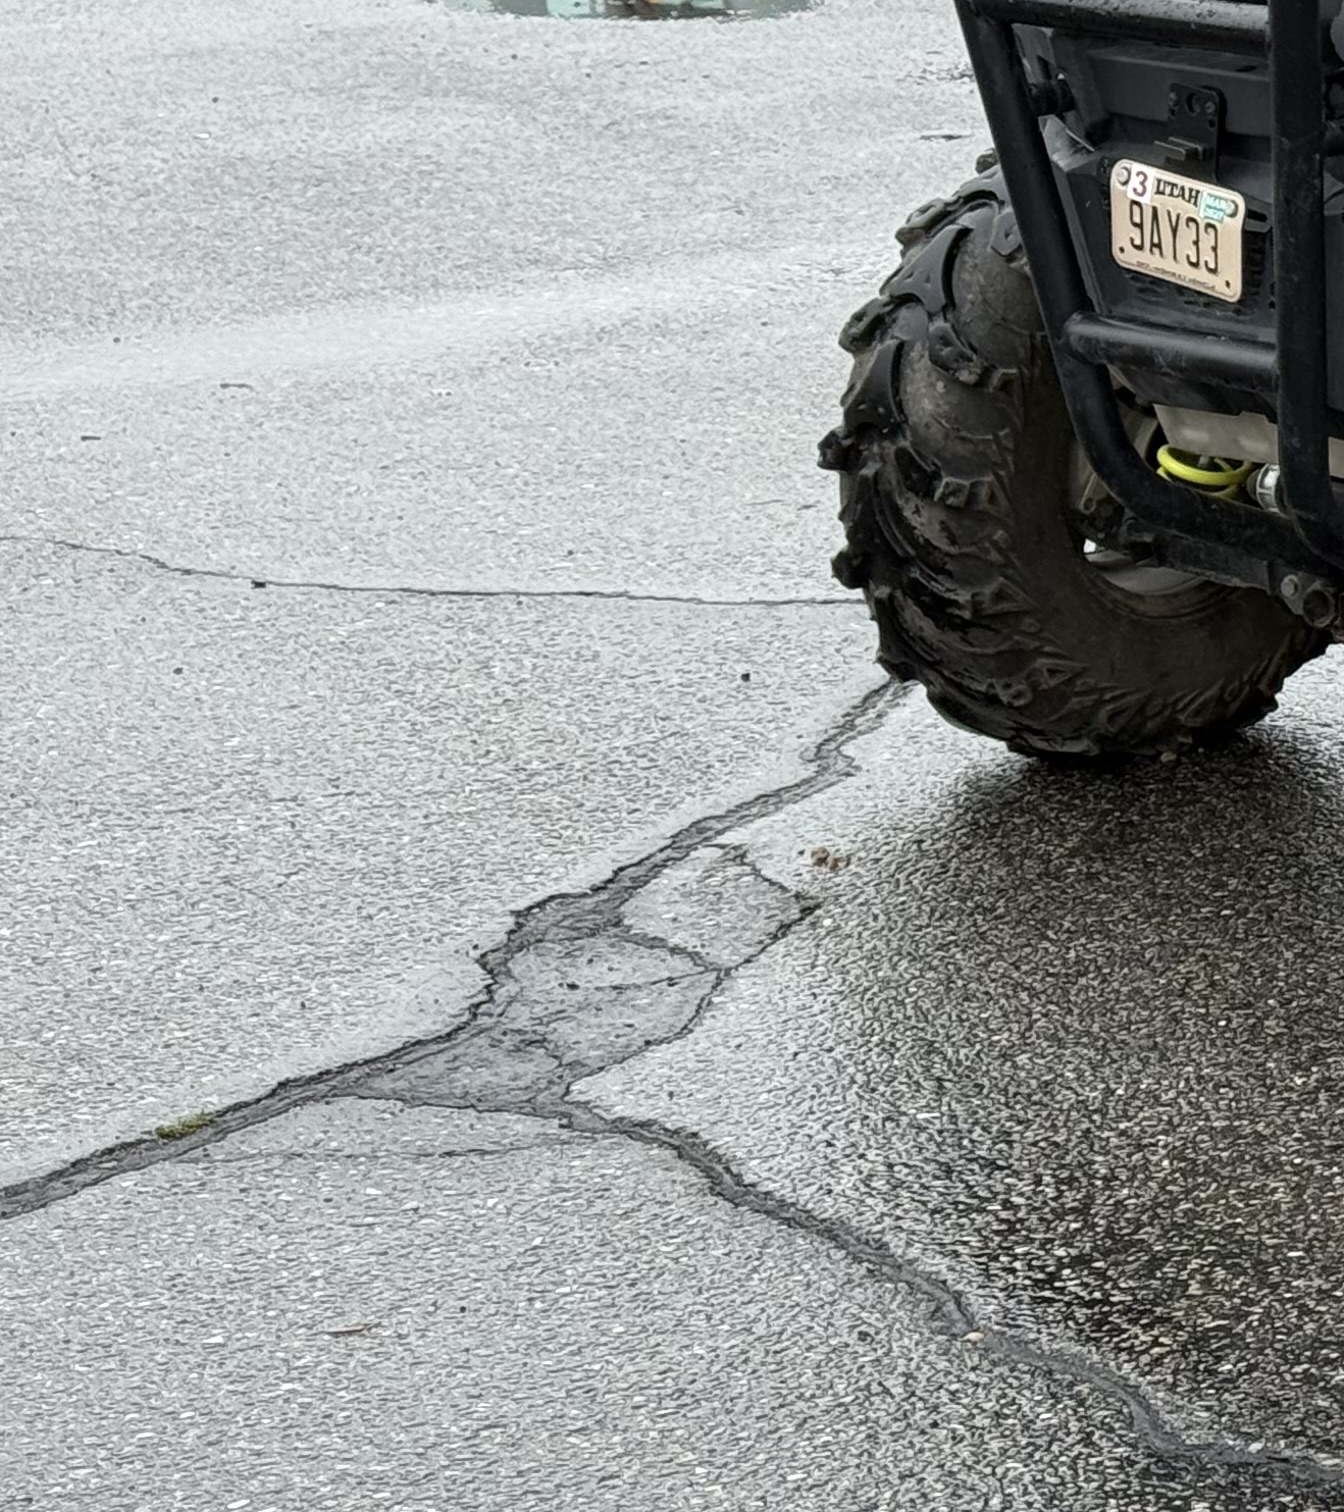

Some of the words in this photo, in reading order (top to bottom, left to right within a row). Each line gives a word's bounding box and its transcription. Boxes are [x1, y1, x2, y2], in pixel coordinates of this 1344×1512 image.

[1132, 170, 1149, 197] 3
[1154, 177, 1201, 208] UTAH
[1129, 199, 1219, 276] 9AY33
